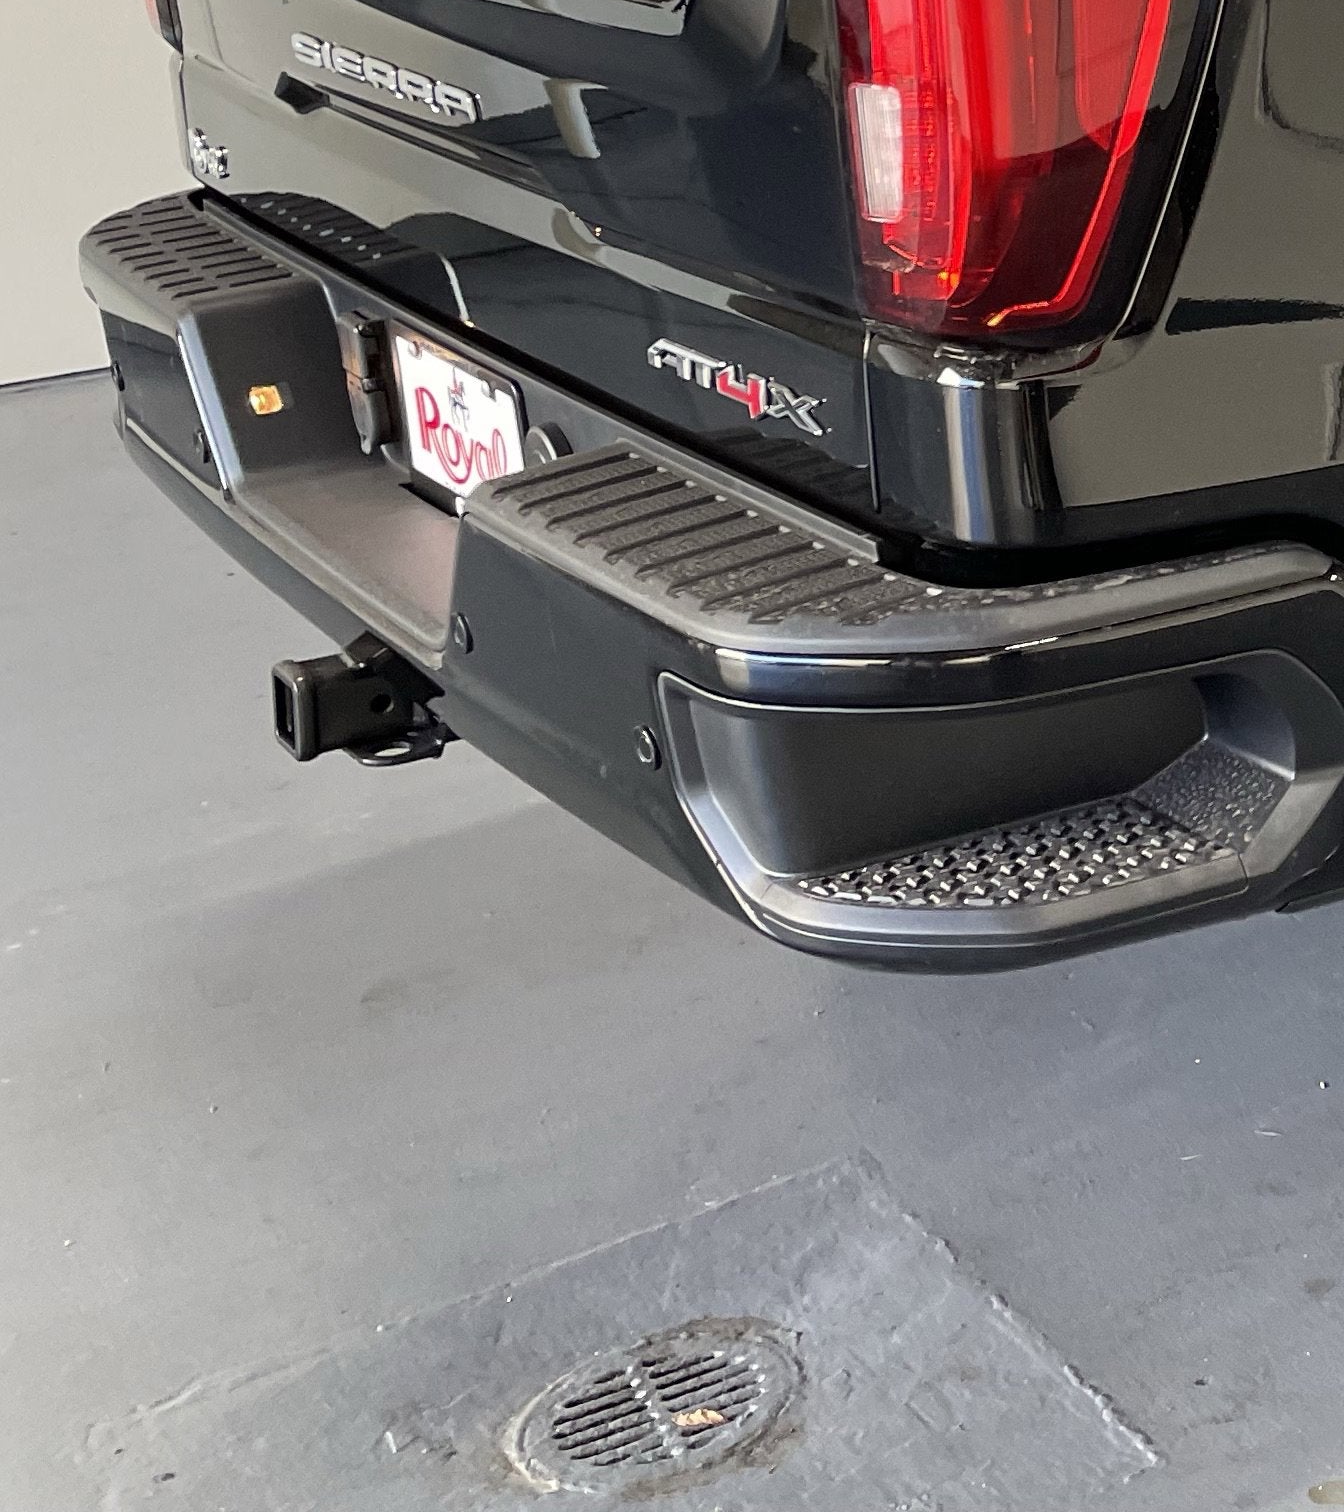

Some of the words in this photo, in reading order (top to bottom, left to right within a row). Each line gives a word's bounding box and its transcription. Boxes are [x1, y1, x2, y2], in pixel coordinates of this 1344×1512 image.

[291, 31, 482, 125] SIERRA
[415, 387, 508, 484] Royal
[647, 338, 832, 437] AT4X
